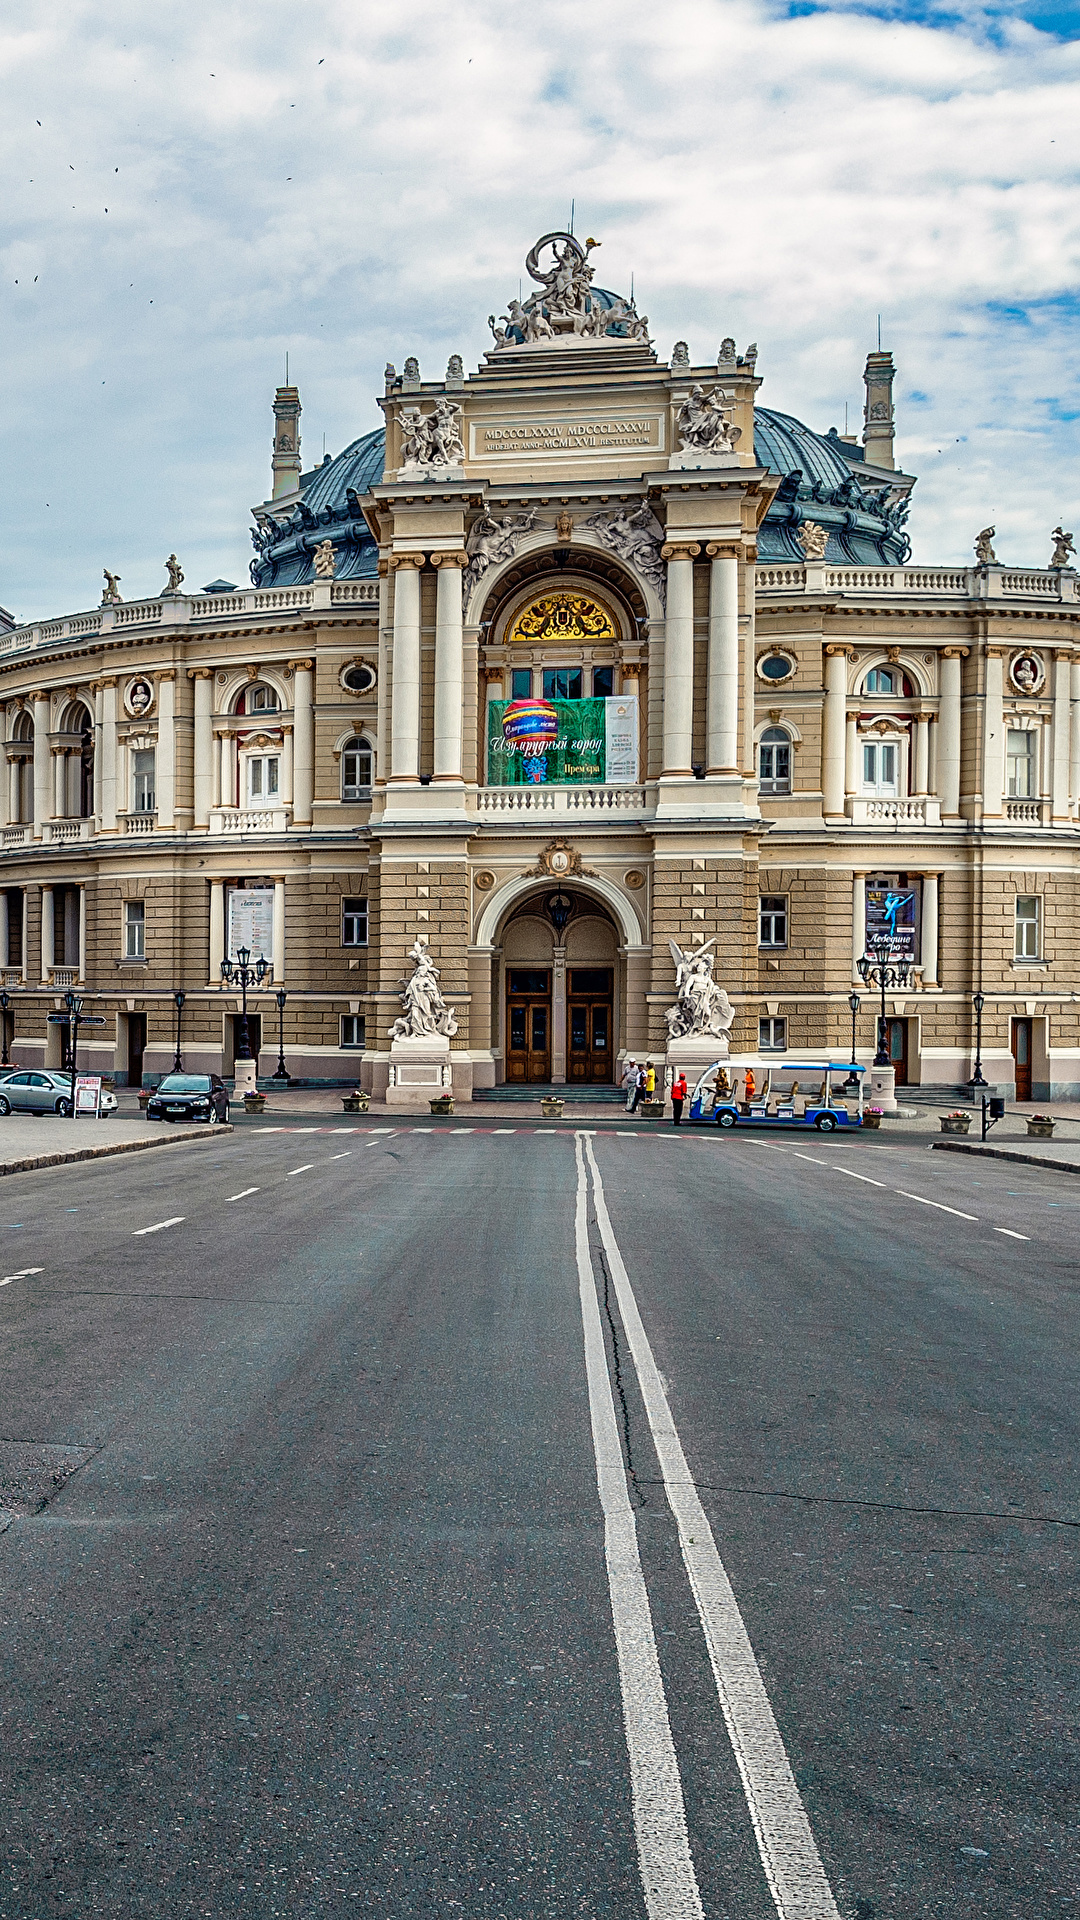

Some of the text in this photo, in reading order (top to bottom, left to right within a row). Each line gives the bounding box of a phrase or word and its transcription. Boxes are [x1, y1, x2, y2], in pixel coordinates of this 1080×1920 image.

[485, 422, 651, 440] MDCCCLXXXIV MDCCCLXXXVII
[490, 735, 603, 757] Изумрудный город
